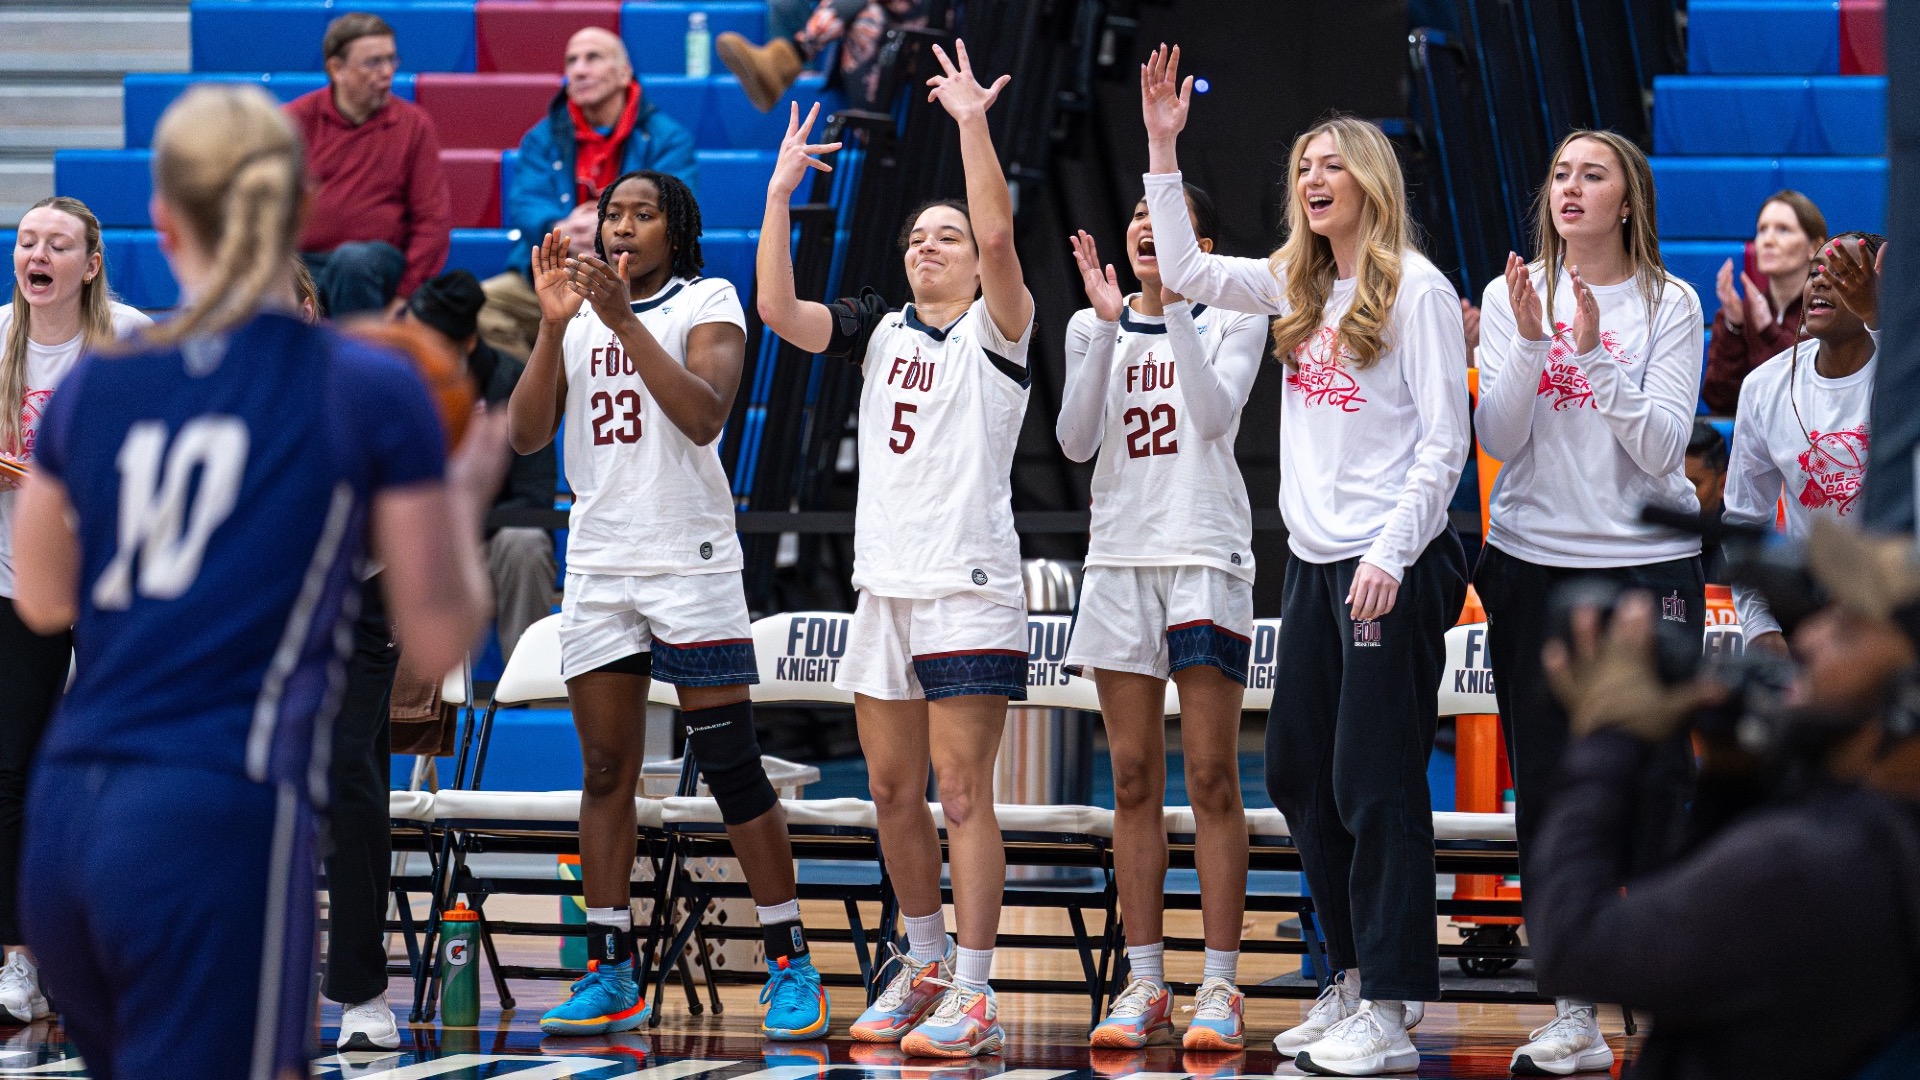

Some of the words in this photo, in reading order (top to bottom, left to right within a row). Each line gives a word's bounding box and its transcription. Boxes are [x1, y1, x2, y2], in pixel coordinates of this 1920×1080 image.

[590, 347, 637, 378] FDU
[887, 356, 936, 393] FDU
[1126, 361, 1175, 394] FDU
[1550, 363, 1579, 376] WE
[1550, 373, 1590, 390] BACK
[590, 389, 643, 447] 23
[888, 401, 918, 455] 5
[1123, 403, 1178, 459] 22
[1820, 471, 1846, 484] WE
[90, 414, 250, 612] 10
[786, 616, 849, 659] FDU
[1353, 621, 1382, 643] FDU
[445, 939, 468, 967] G
